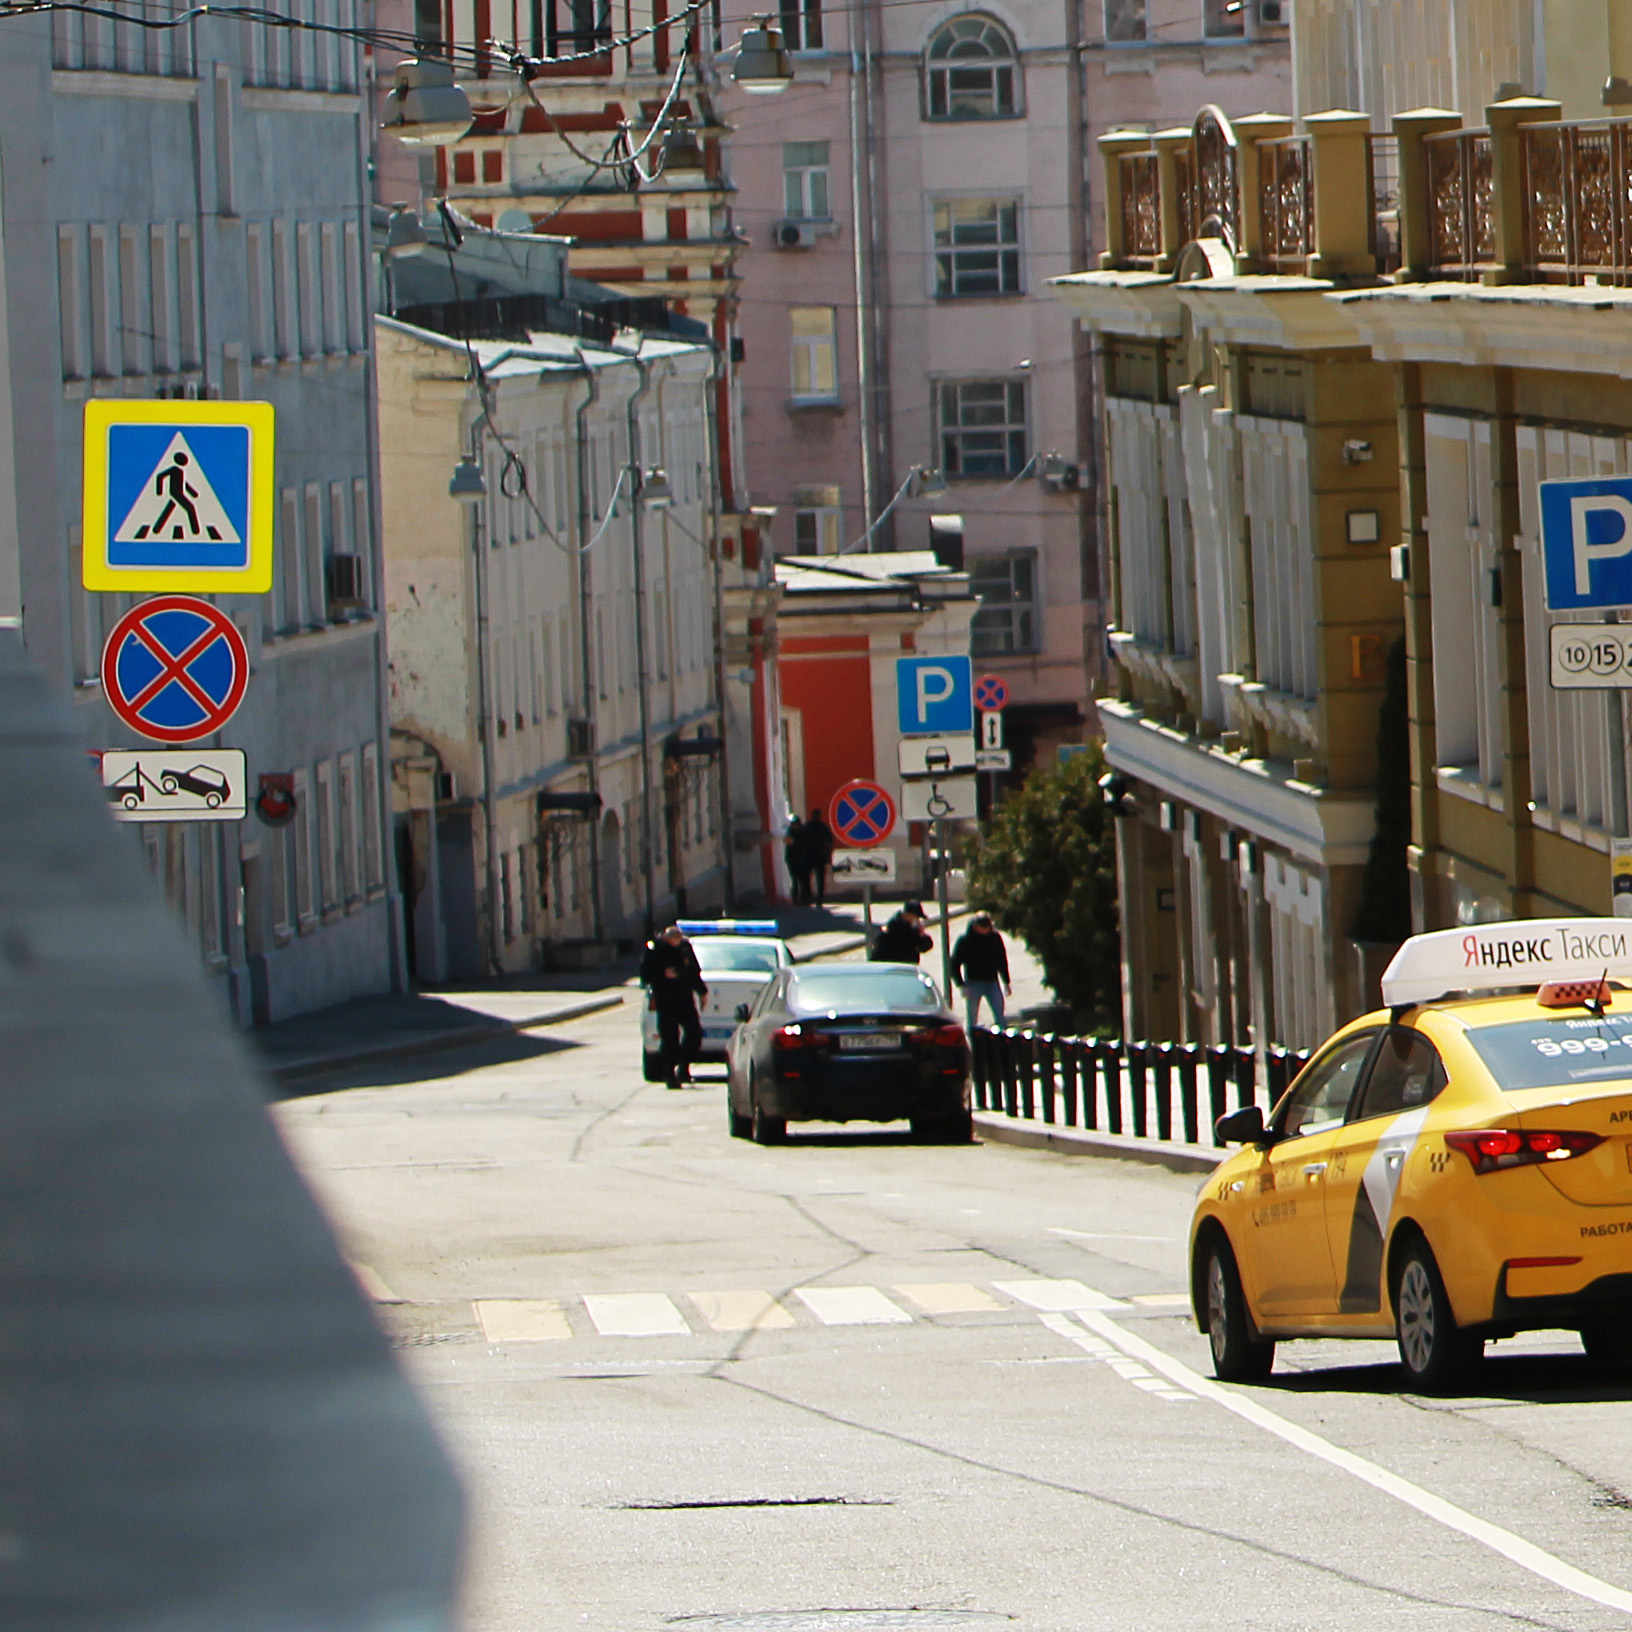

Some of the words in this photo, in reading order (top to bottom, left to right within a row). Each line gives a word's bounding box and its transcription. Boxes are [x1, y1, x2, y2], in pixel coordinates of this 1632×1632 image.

[1564, 647, 1585, 664] 10
[1594, 644, 1617, 666] 15
[916, 666, 954, 724] P
[1462, 934, 1553, 968] Яндекс
[1556, 928, 1627, 960] Такси
